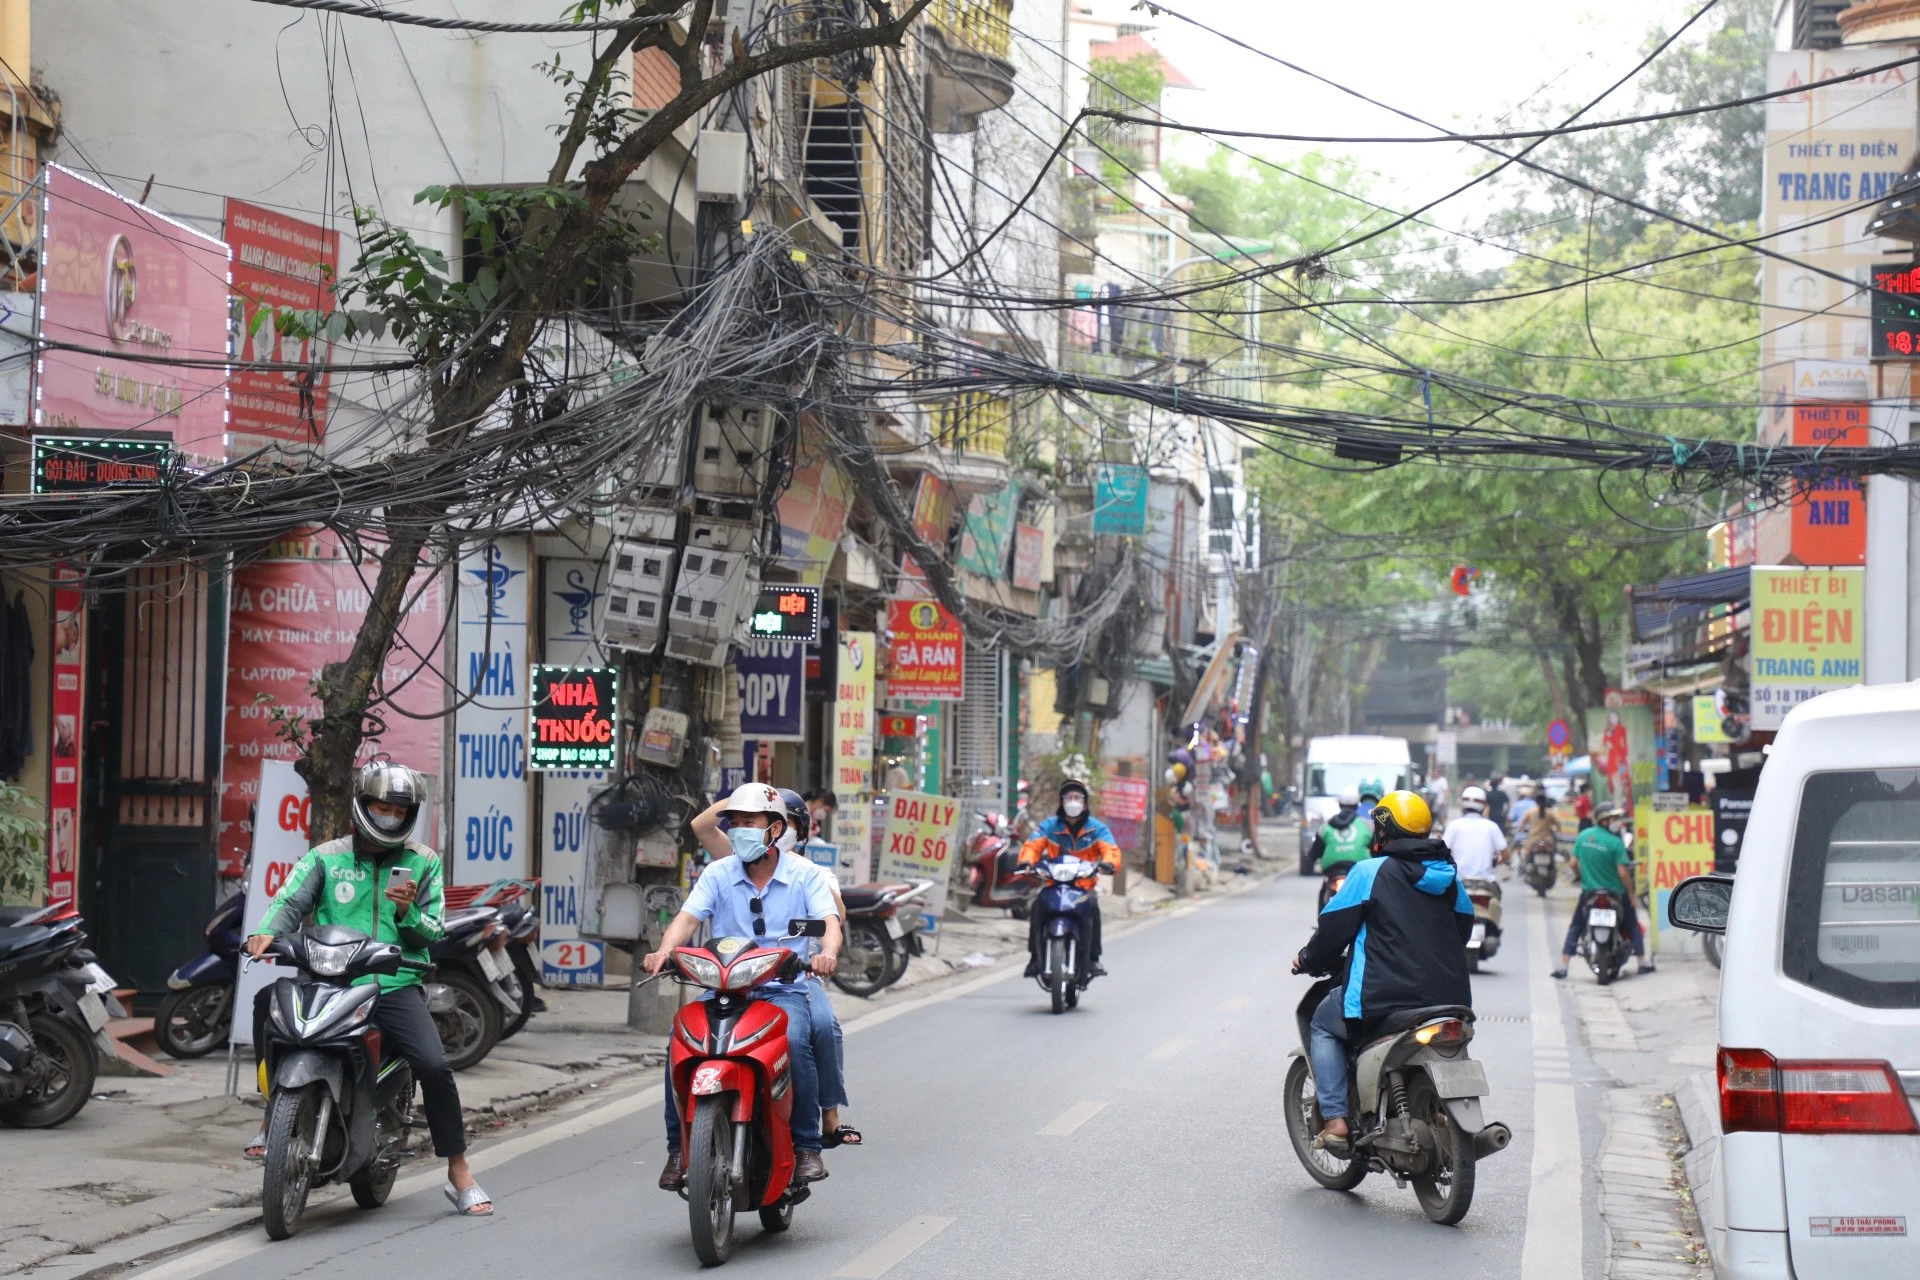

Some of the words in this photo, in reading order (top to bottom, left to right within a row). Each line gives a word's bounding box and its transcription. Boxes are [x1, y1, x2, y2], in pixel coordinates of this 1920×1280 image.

[1819, 67, 1906, 84] ASIA
[1788, 138, 1832, 157] THIẾT
[1839, 143, 1855, 160] BỊ
[1860, 139, 1898, 158] ĐIỆN
[1778, 171, 1851, 202] TRANG
[1809, 500, 1850, 525] ANH
[260, 582, 319, 612] CHỮA
[1768, 574, 1821, 594] THIẾT
[1828, 577, 1847, 598] BỊ
[1762, 601, 1854, 652] ĐIỆN
[897, 641, 919, 666] GÀ
[922, 641, 956, 666] RÁN
[241, 667, 296, 682] LAPTOP
[469, 641, 514, 696] NHÀ
[1756, 658, 1815, 677] TRANG
[1821, 657, 1860, 677] ANH
[550, 676, 598, 706] NHÀ
[1777, 689, 1790, 702] 18
[537, 709, 611, 743] THUỐC
[459, 717, 523, 779] THUỐC
[536, 748, 560, 761] SHOP
[561, 748, 578, 761] BAO
[579, 748, 597, 761] CAO
[598, 749, 610, 761] SU
[895, 798, 927, 825] ĐẠI
[931, 801, 955, 826] LÝ
[466, 804, 513, 861] ĐỨC
[890, 827, 919, 856] XỔ
[921, 833, 948, 861] SỐ
[329, 865, 367, 882] Grab
[558, 944, 587, 965] 21
